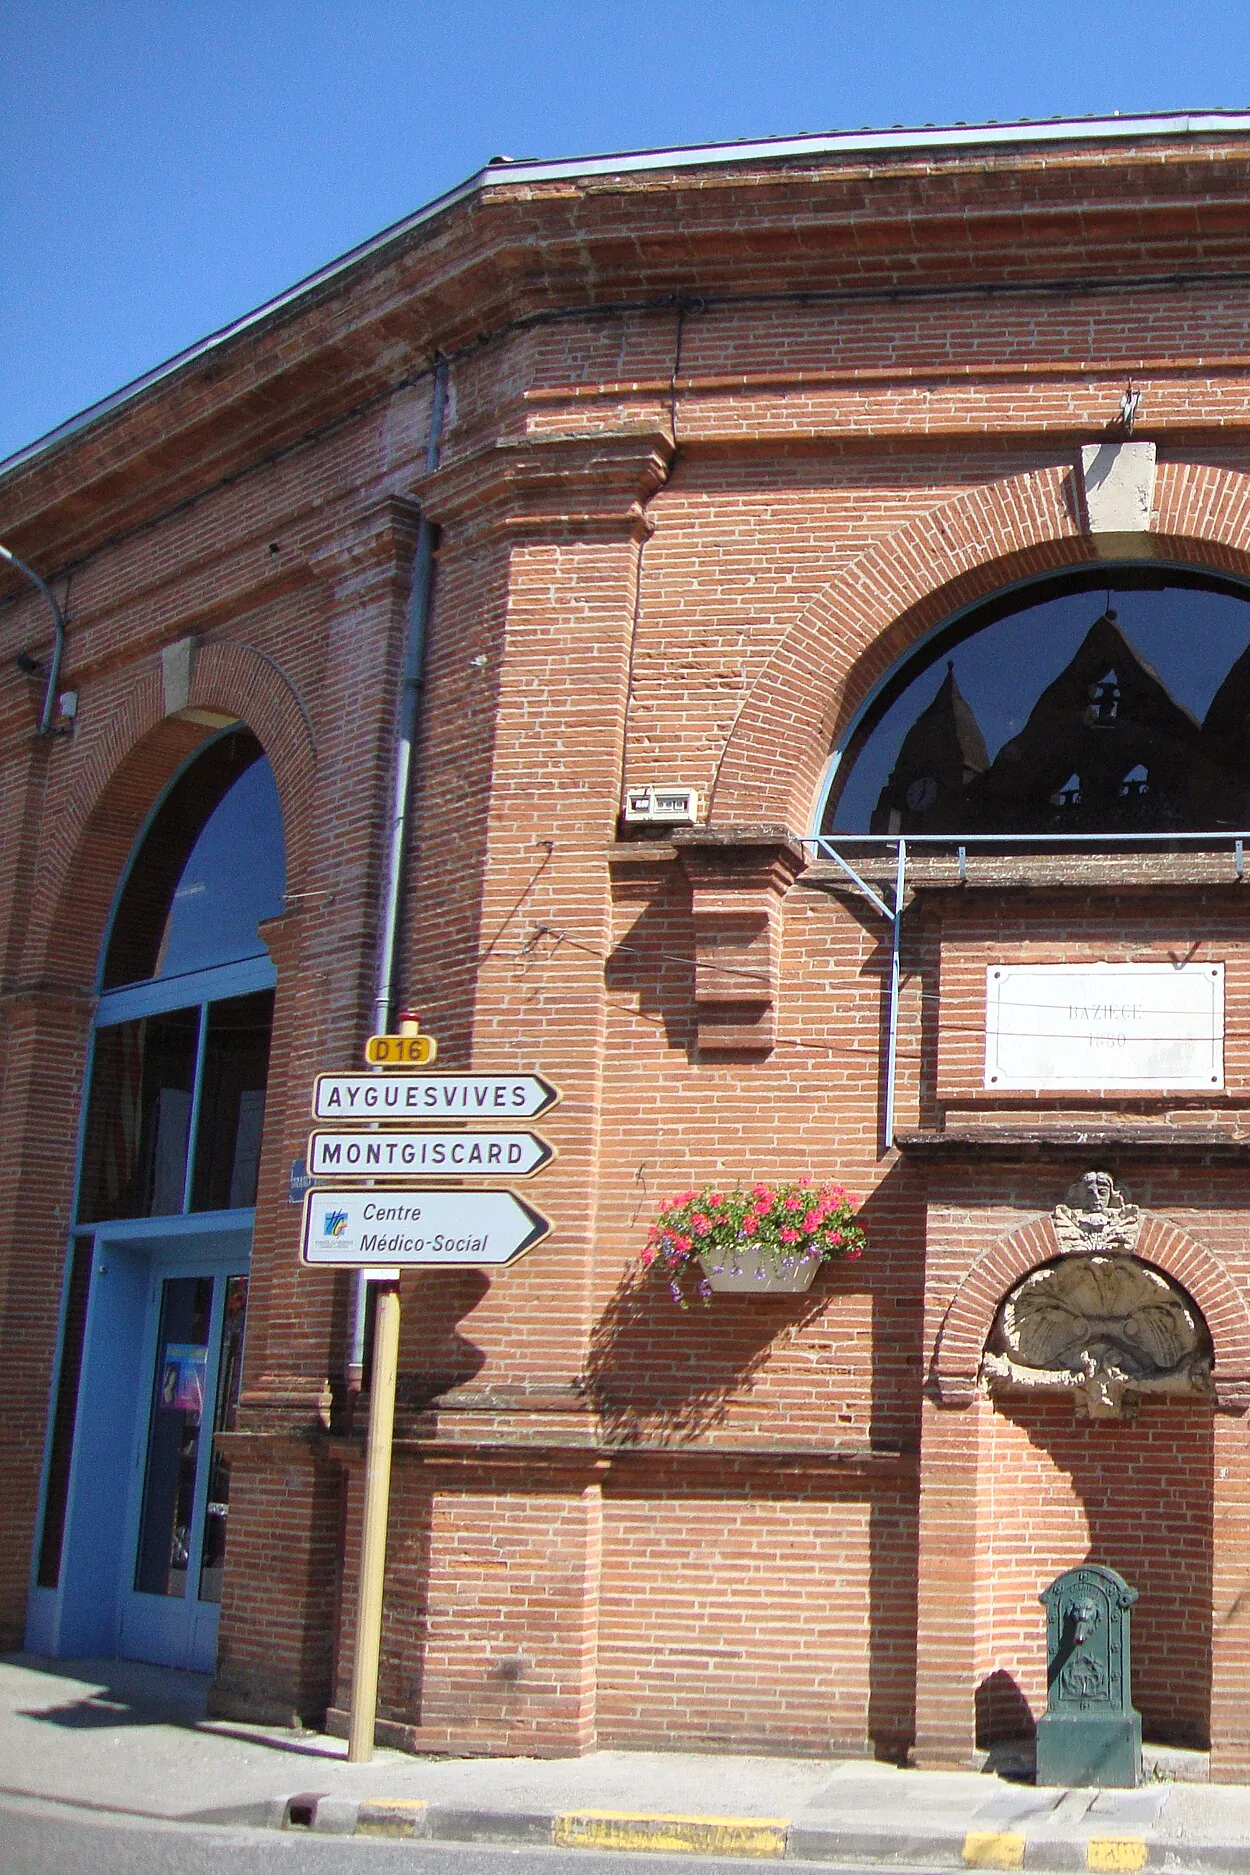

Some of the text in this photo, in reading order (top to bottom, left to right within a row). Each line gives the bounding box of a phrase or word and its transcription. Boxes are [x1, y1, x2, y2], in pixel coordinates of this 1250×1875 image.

[327, 1086, 527, 1107] AYGUESVIVES
[322, 1143, 523, 1164] MONTGISCARD
[363, 1203, 421, 1221] Centre
[360, 1234, 488, 1252] Médico-Social
